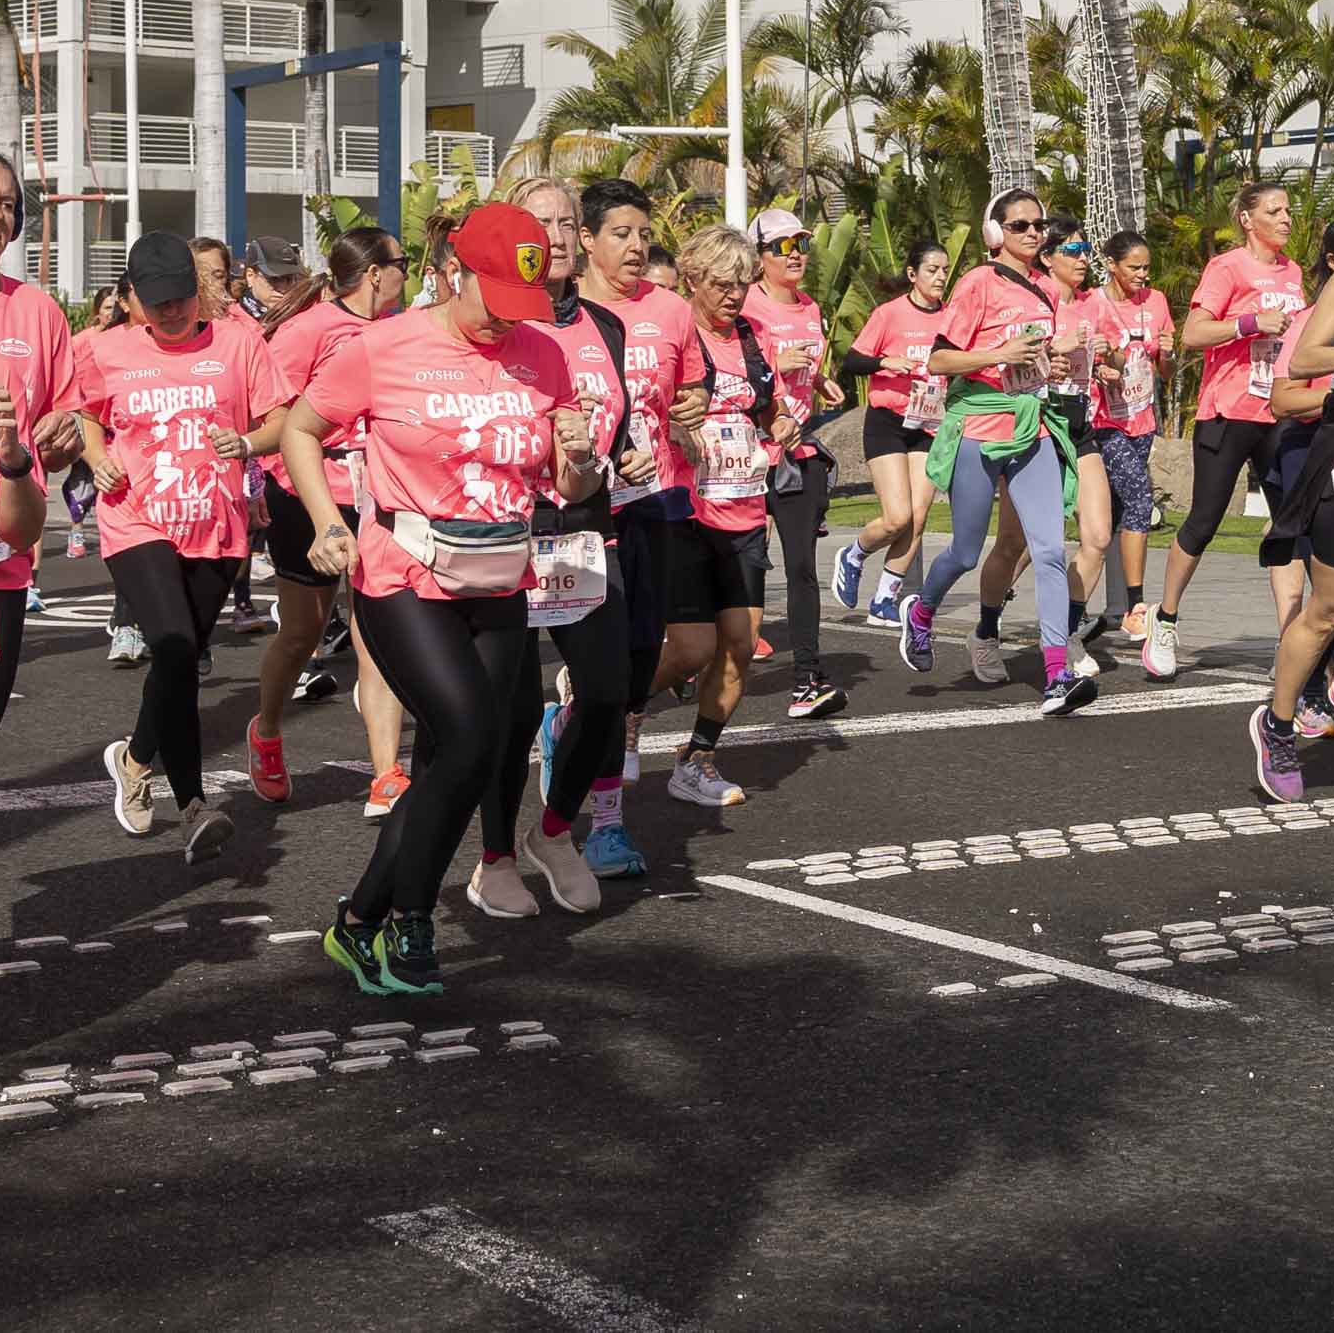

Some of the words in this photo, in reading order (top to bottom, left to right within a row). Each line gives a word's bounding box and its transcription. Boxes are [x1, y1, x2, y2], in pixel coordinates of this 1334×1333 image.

[123, 369, 163, 380] OYSHO
[416, 370, 464, 381] OYSHO
[1023, 368, 1037, 380] 01
[1125, 385, 1143, 397] 016
[129, 385, 217, 416] CARRERA
[426, 391, 537, 419] CARRERA
[178, 417, 205, 451] DE
[493, 423, 528, 465] DE
[725, 456, 752, 469] 016
[147, 498, 213, 524] MUJER
[538, 574, 575, 590] 016
